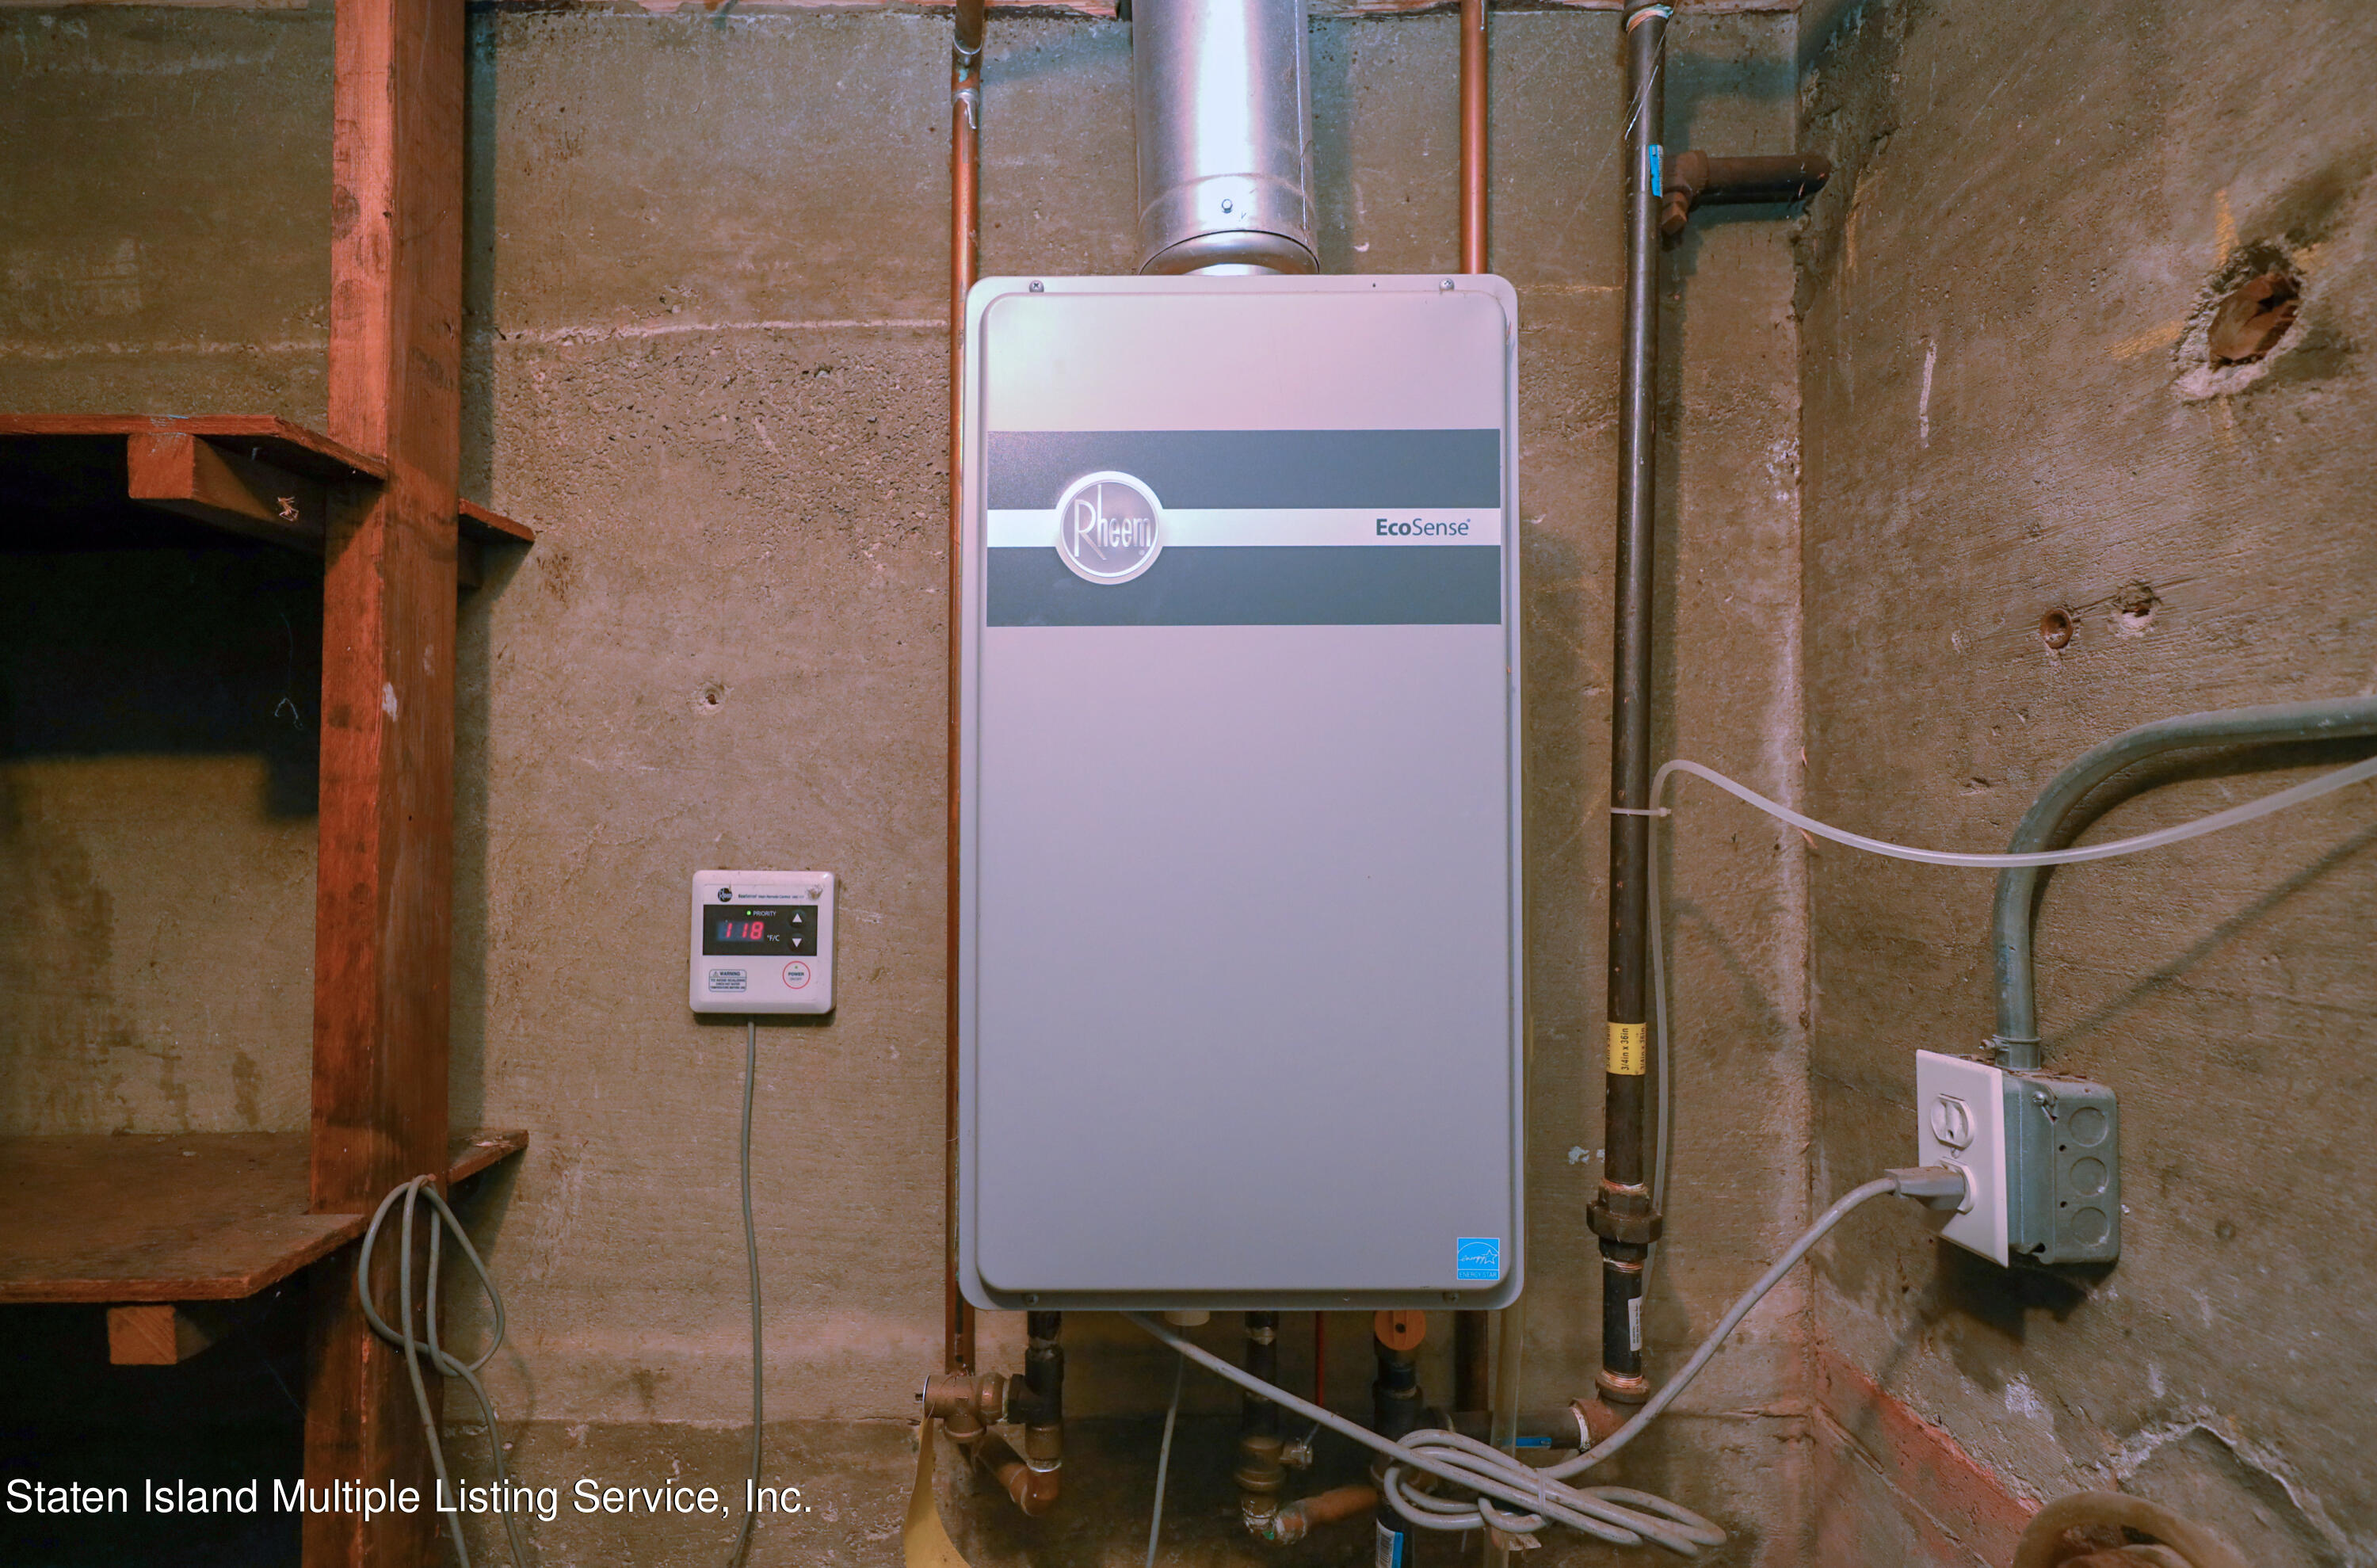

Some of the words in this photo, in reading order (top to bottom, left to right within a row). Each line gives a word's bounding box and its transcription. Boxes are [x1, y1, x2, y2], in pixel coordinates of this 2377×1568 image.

[1074, 484, 1152, 561] Rheem
[1375, 517, 1470, 536] EcoSense
[726, 921, 764, 940] 118
[1620, 1028, 1629, 1044] 36in
[1620, 1052, 1630, 1070] 3/4in
